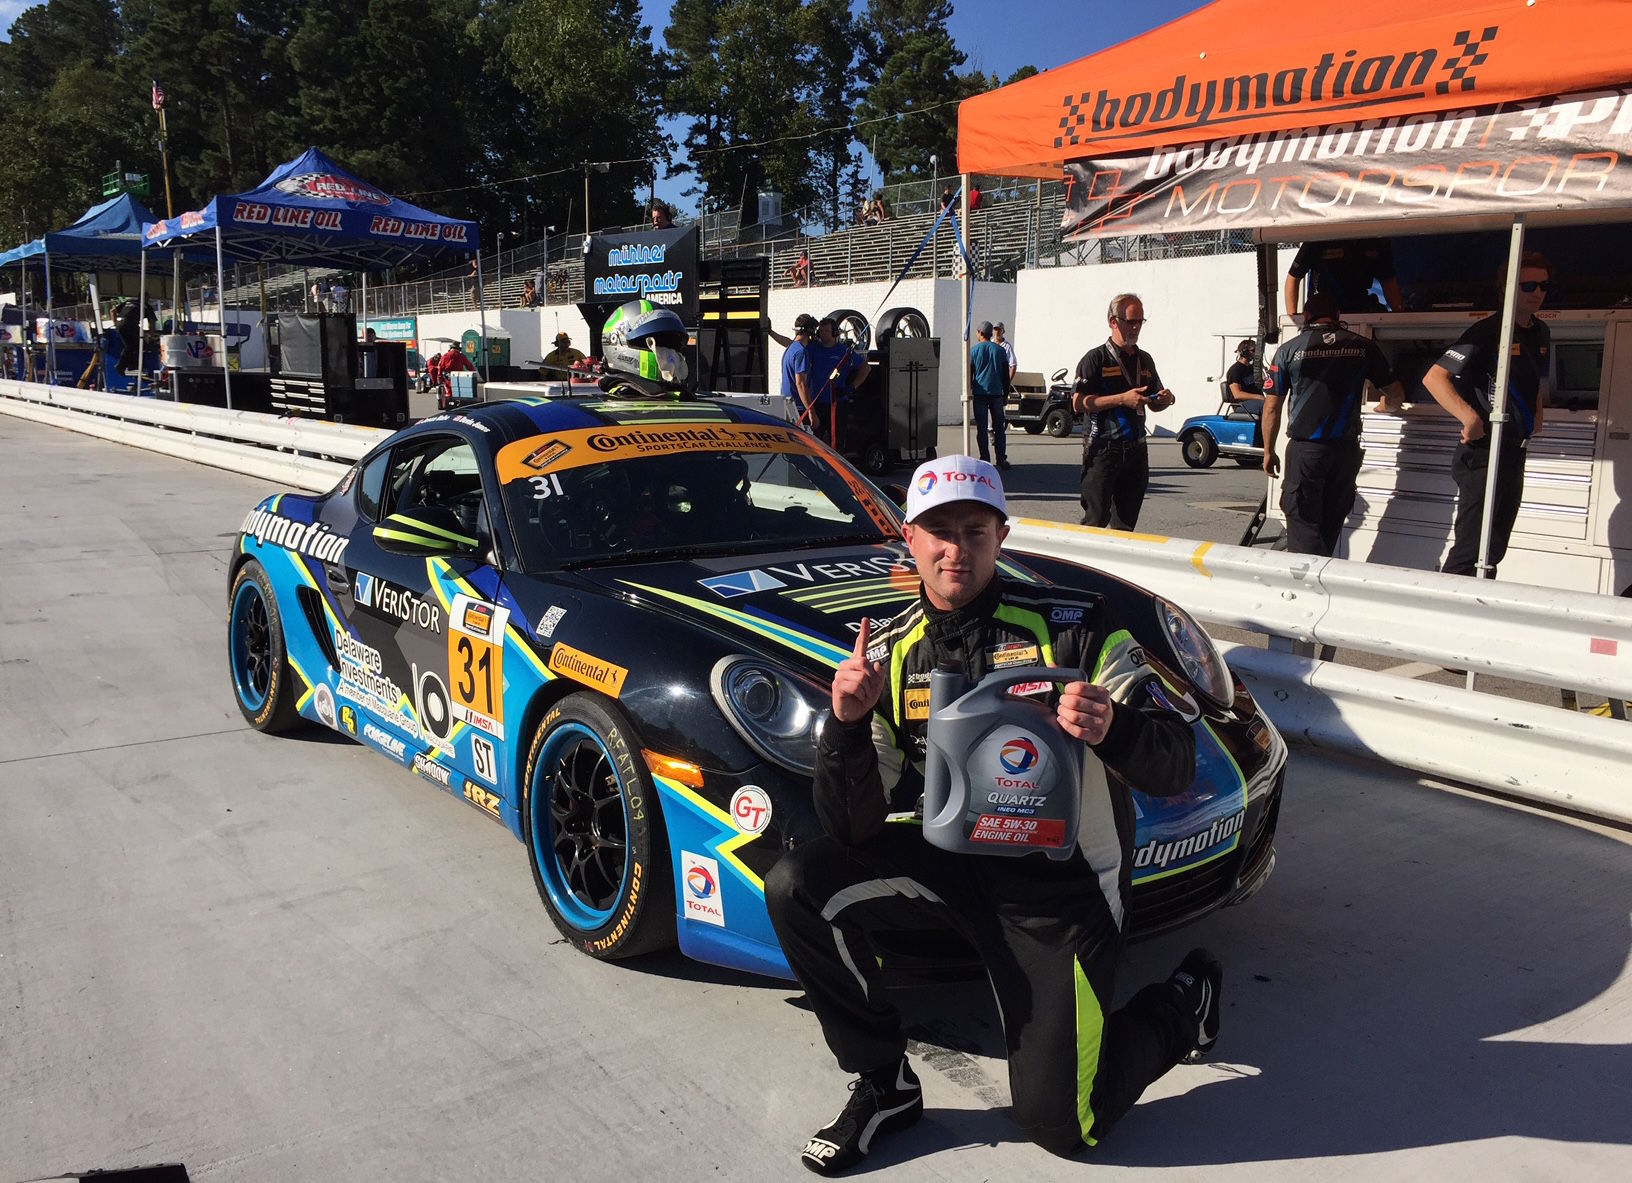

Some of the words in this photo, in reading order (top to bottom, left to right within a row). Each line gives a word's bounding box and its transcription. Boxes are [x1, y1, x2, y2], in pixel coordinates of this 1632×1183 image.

[1091, 49, 1438, 132] bodymotion
[1163, 151, 1632, 217] MOTORSPOR
[233, 202, 270, 224] RED
[272, 207, 315, 227] LINE
[314, 210, 342, 231] OIL
[370, 216, 404, 235] RED
[404, 221, 440, 240] LINE
[442, 224, 467, 243] OIL
[594, 270, 683, 299] motorsports
[646, 292, 683, 305] AMERICA
[186, 340, 206, 359] VP
[586, 428, 720, 453] Continental
[747, 431, 795, 444] TIRE
[528, 473, 566, 500] 31
[942, 471, 997, 490] TOTAL
[1051, 609, 1083, 621] OMP
[335, 629, 382, 672] Delaware
[457, 636, 493, 714] 31
[553, 648, 609, 684] Continental
[473, 713, 495, 732] IMSA
[474, 738, 492, 778] ST
[995, 776, 1040, 789] TOTAL
[736, 795, 766, 828] GT
[987, 791, 1047, 806] QUARTZ
[974, 829, 1013, 841] ENGINE
[1013, 833, 1030, 842] OIL
[979, 816, 1002, 828] SAE
[1003, 818, 1038, 831] 5W-30
[1132, 809, 1245, 868] dymotion
[593, 862, 642, 951] CONTINENTAL
[686, 899, 722, 917] TOTAL
